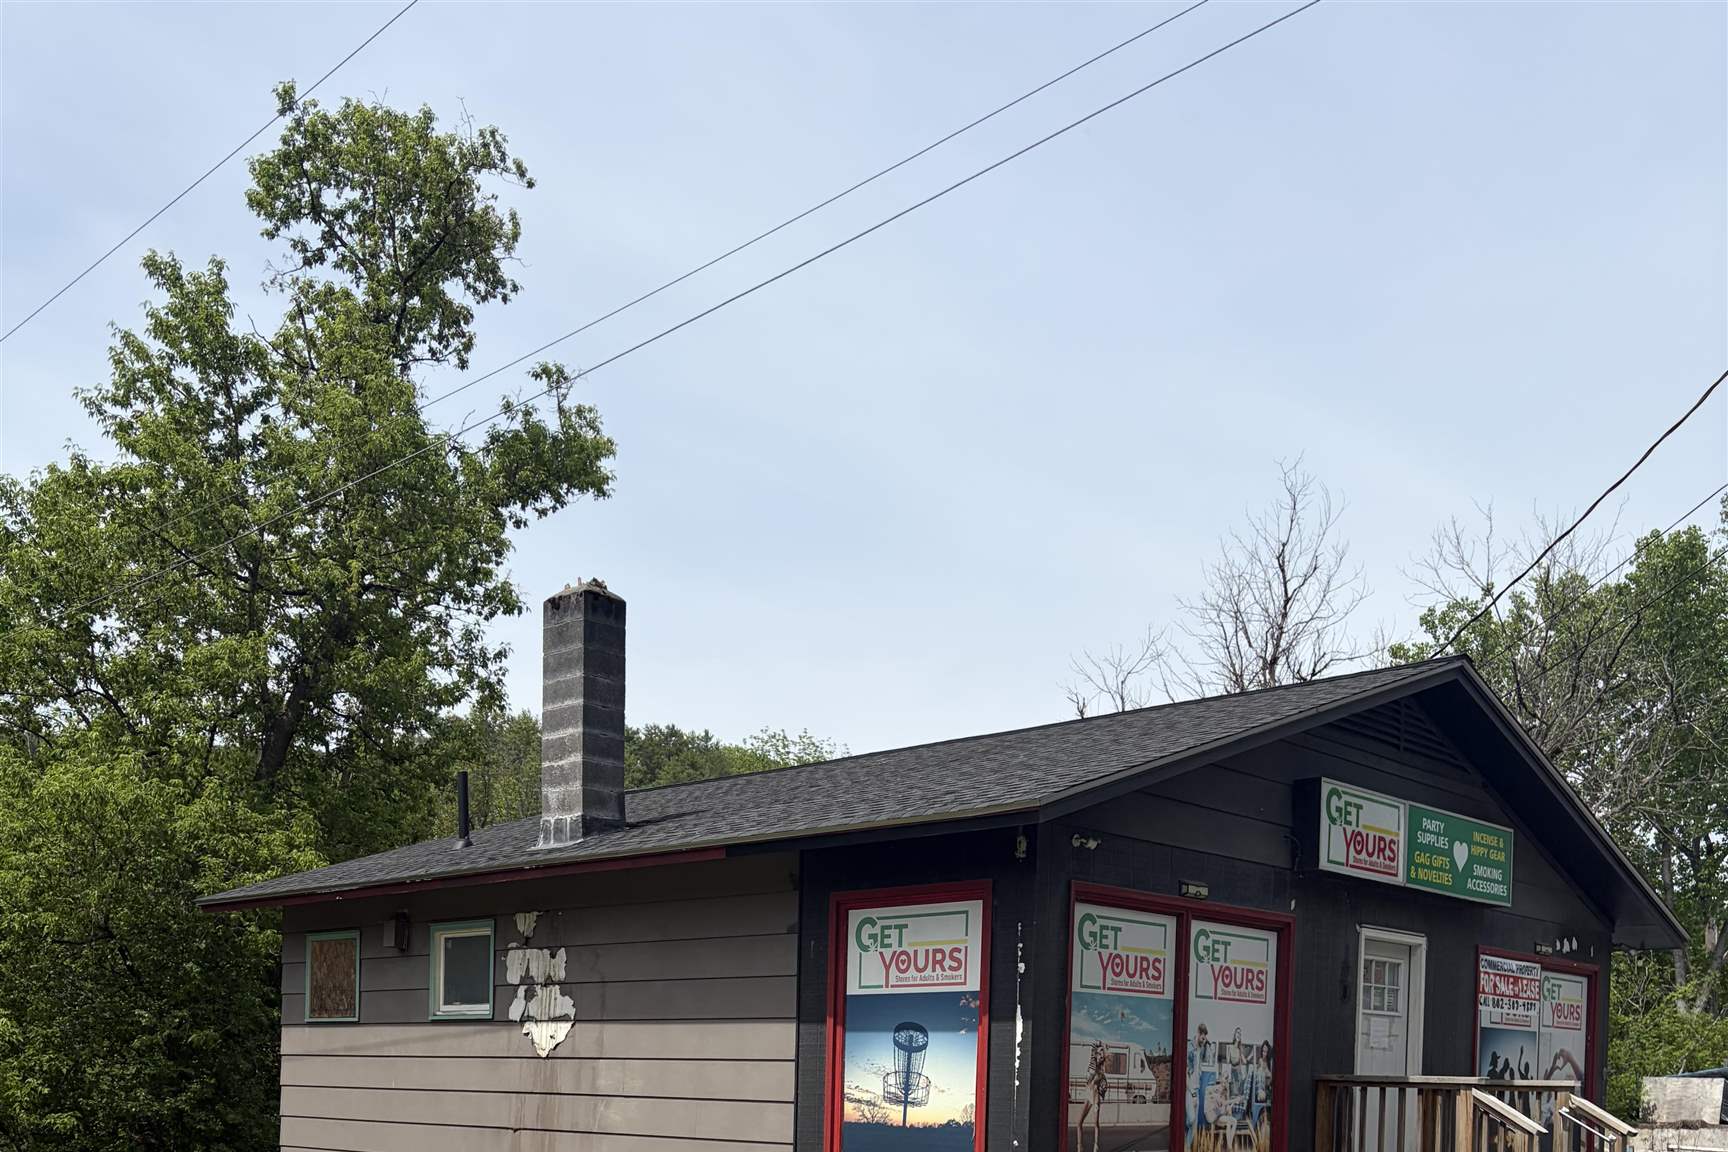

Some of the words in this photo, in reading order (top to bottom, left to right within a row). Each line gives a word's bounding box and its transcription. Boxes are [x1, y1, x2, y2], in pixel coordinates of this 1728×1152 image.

[1326, 787, 1363, 827] GET
[1422, 818, 1445, 834] PARTY
[1343, 827, 1397, 867] YOURS
[1417, 831, 1449, 849] SUPPLIES
[1472, 832, 1498, 847] INCENSE
[1499, 838, 1504, 848] &
[1415, 851, 1430, 866] GAG
[1432, 854, 1450, 869] GIFTS
[1471, 845, 1488, 858] HIPPY
[1489, 849, 1505, 863] GEAR
[1410, 866, 1416, 879] &
[1418, 868, 1453, 885] NOVELTIES
[1473, 864, 1502, 882] SMOKING
[1467, 878, 1508, 897] ACCESSORIES
[855, 916, 908, 952] GET
[1078, 913, 1122, 951] GET
[1194, 928, 1231, 963] GET
[879, 947, 963, 988] YOURS
[1098, 951, 1162, 990] YOURS
[1480, 958, 1516, 974] COMMERCIAL
[1517, 962, 1539, 977] PROPERTY
[1211, 964, 1264, 1000] YOURS
[1480, 973, 1494, 993] FOR
[1496, 975, 1513, 996] SALE
[1519, 979, 1540, 1000] LEASE
[1542, 976, 1562, 1001] GET
[1551, 1002, 1581, 1028] YOURS
